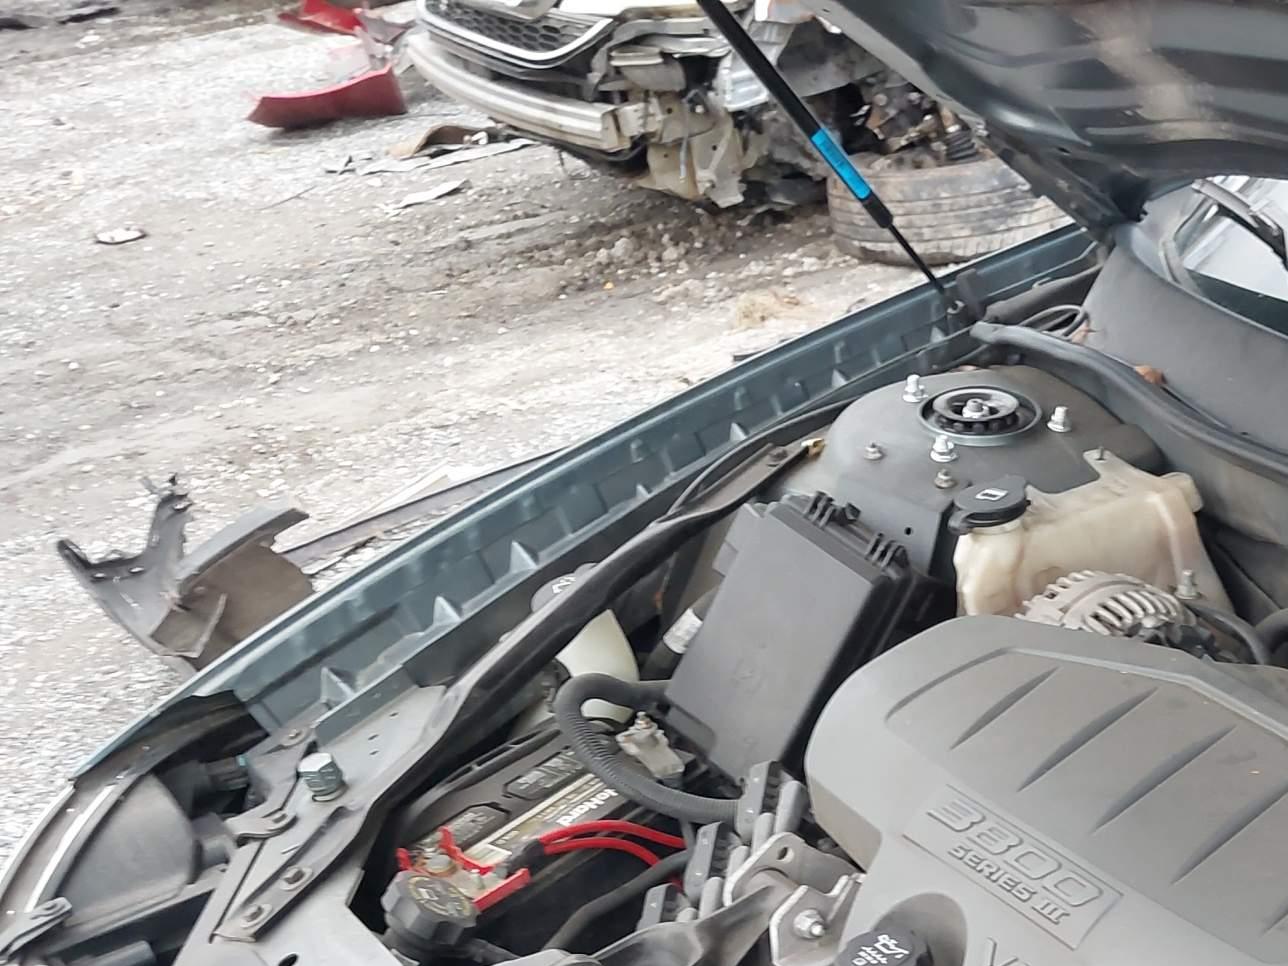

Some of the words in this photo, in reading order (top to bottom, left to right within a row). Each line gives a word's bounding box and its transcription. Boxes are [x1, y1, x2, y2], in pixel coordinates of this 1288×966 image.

[926, 798, 1105, 908] 3800
[947, 841, 1038, 903] SERIES
[1031, 897, 1071, 926] III
